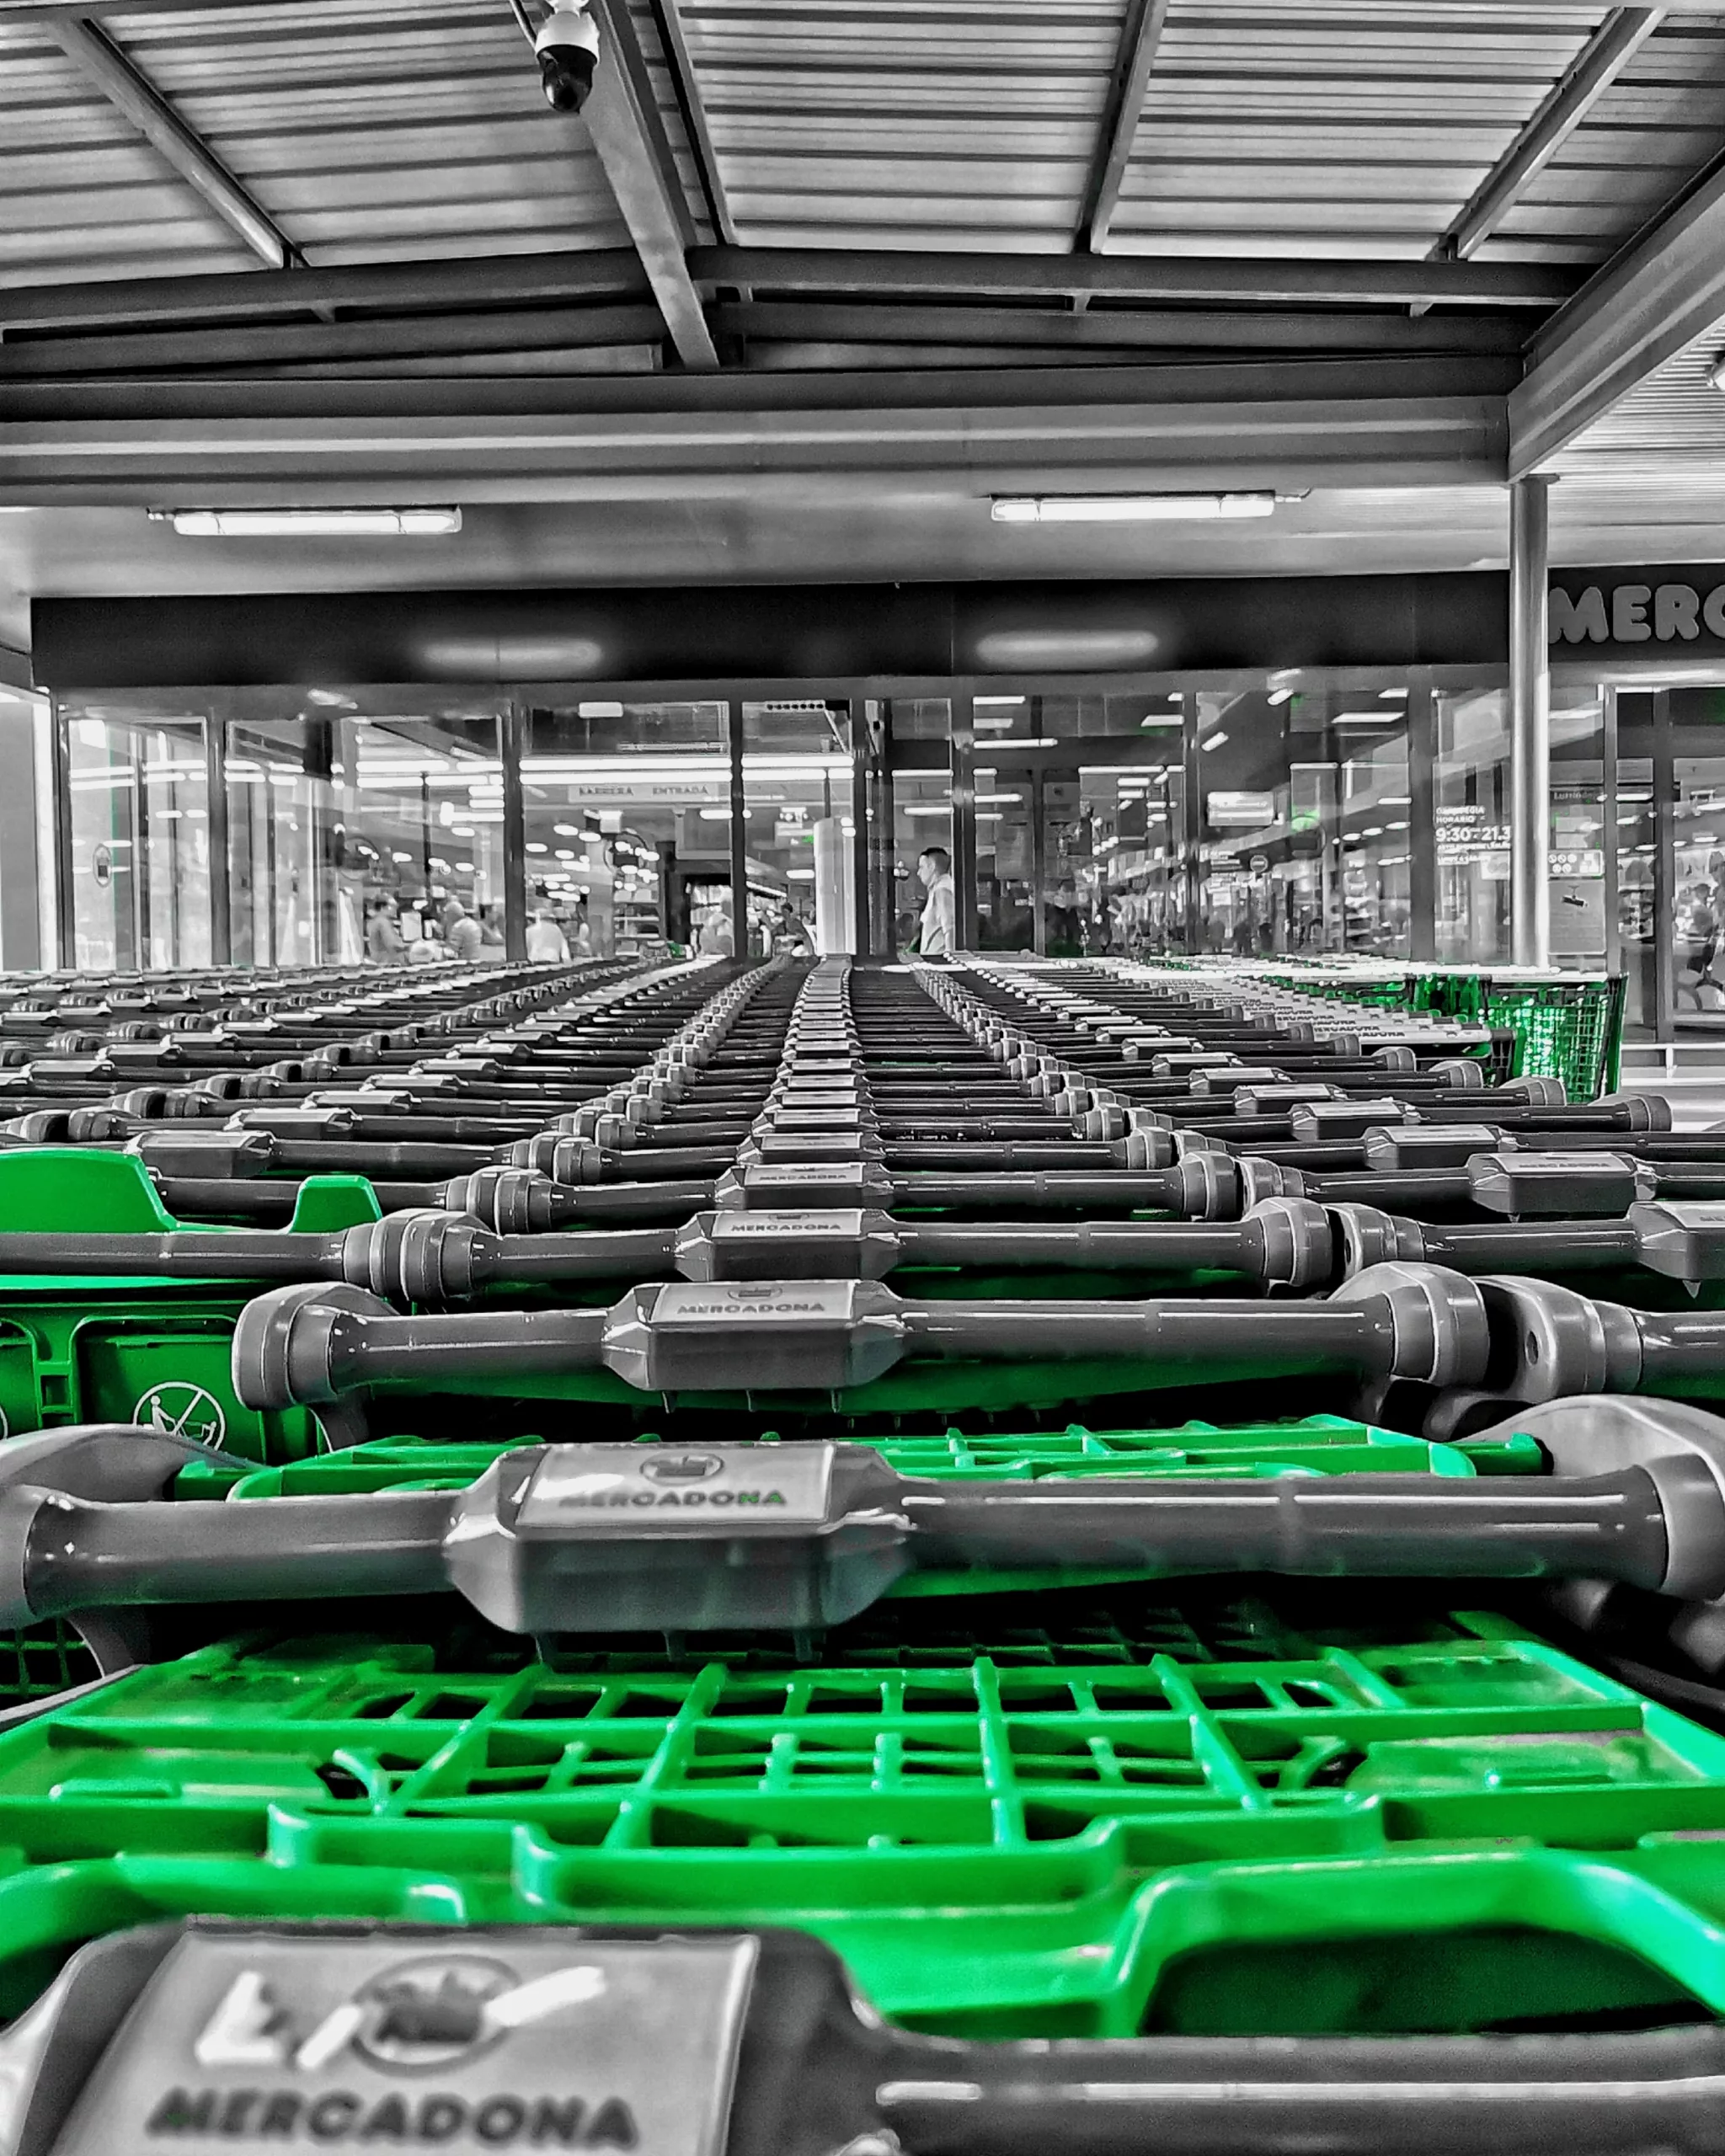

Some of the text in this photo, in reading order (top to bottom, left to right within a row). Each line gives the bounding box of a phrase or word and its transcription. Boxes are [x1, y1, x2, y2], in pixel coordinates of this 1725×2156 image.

[1435, 826, 1471, 842] 9:30
[731, 1224, 841, 1232] MERCADONA
[676, 1303, 825, 1315] MERCADONA
[558, 1490, 787, 1508] MERCADONA
[145, 2086, 638, 2149] MERCADONA
